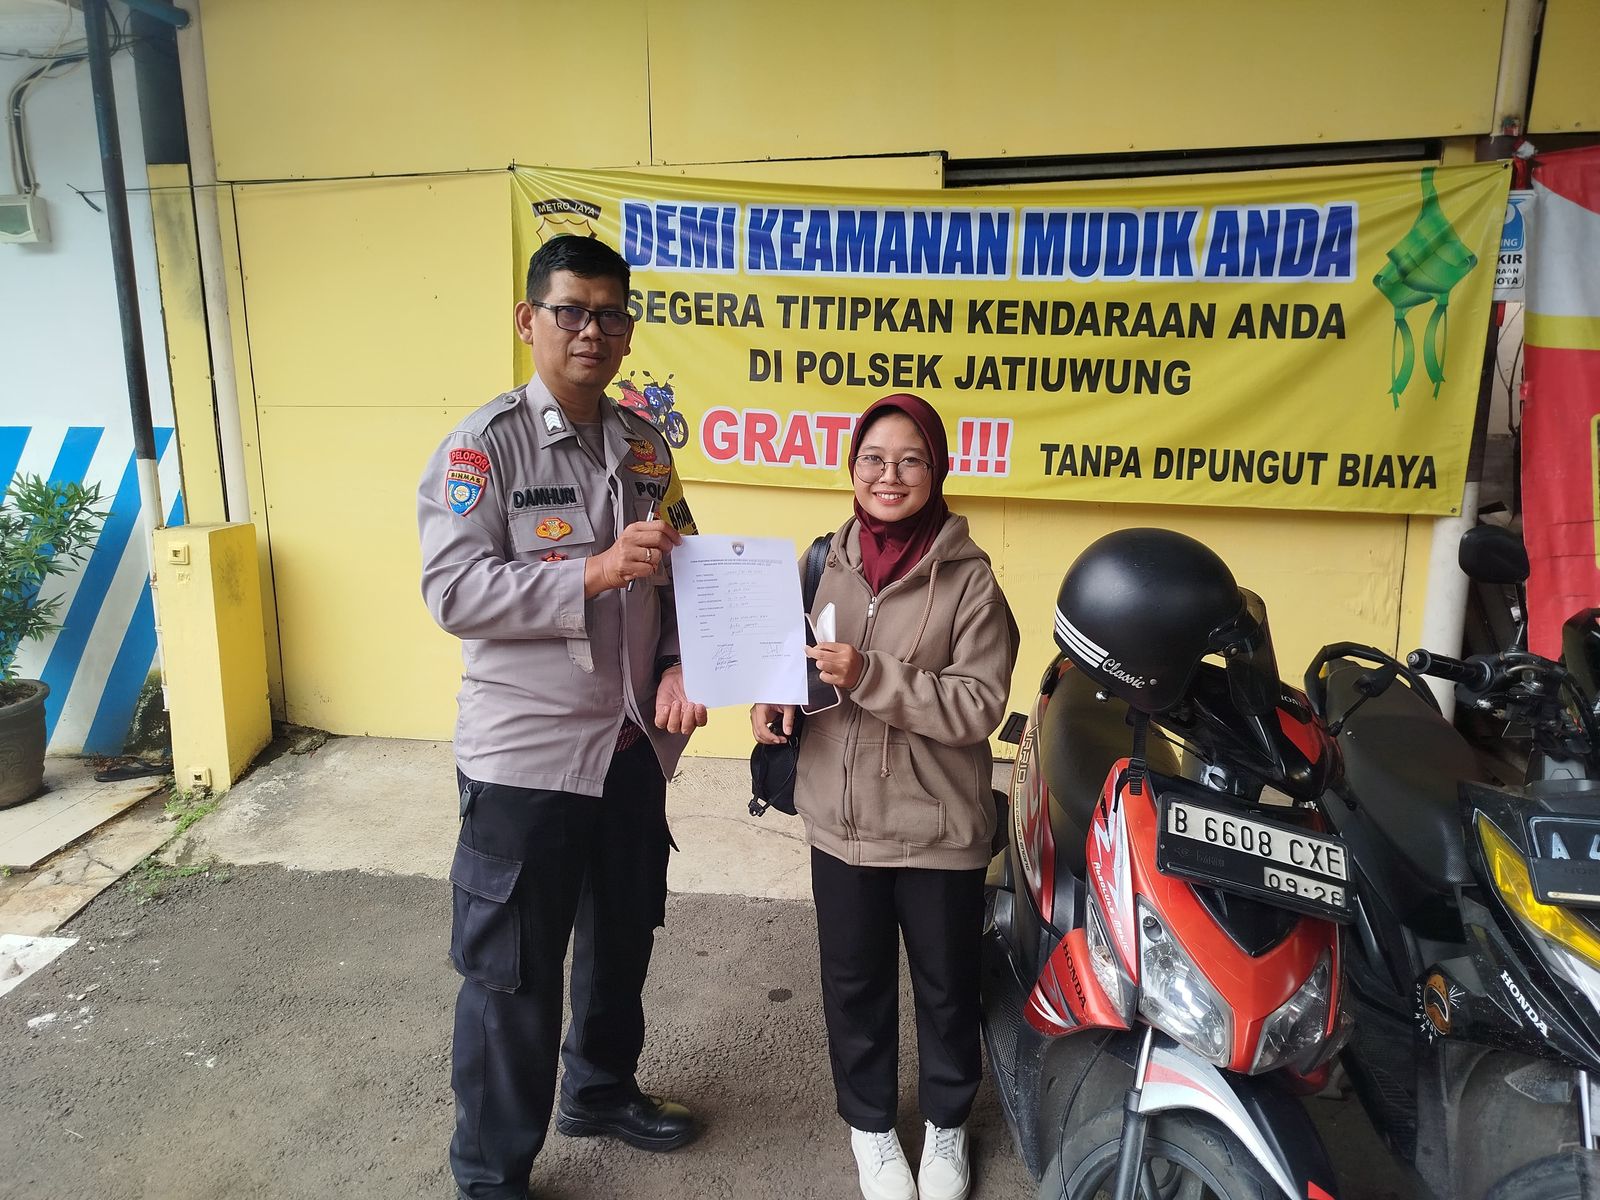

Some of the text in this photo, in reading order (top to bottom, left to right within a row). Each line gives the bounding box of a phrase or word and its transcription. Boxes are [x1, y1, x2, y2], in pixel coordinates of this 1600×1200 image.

[538, 202, 596, 216] METRO JAYA
[622, 202, 1356, 279] DEMI KEAMANAN MUDIK ANDA
[1497, 253, 1523, 265] KIR
[628, 289, 1346, 340] SEGERA TITIPKAN KENDARAAN ANDA
[749, 348, 1191, 395] DI POLSEK JATIUWUNG
[451, 451, 488, 468] PELOPOR
[451, 472, 481, 484] BINMAS
[1040, 443, 1437, 490] TANPA DIPUNGUT BIAYA
[513, 486, 577, 508] DAMHURI
[1102, 658, 1145, 689] Classic
[1017, 724, 1040, 784] VARIO
[1175, 806, 1342, 877] B 6608 CXE
[1063, 942, 1087, 1010] HONDA
[1422, 1013, 1438, 1037] COOL
[1500, 969, 1549, 1039] HONDA
